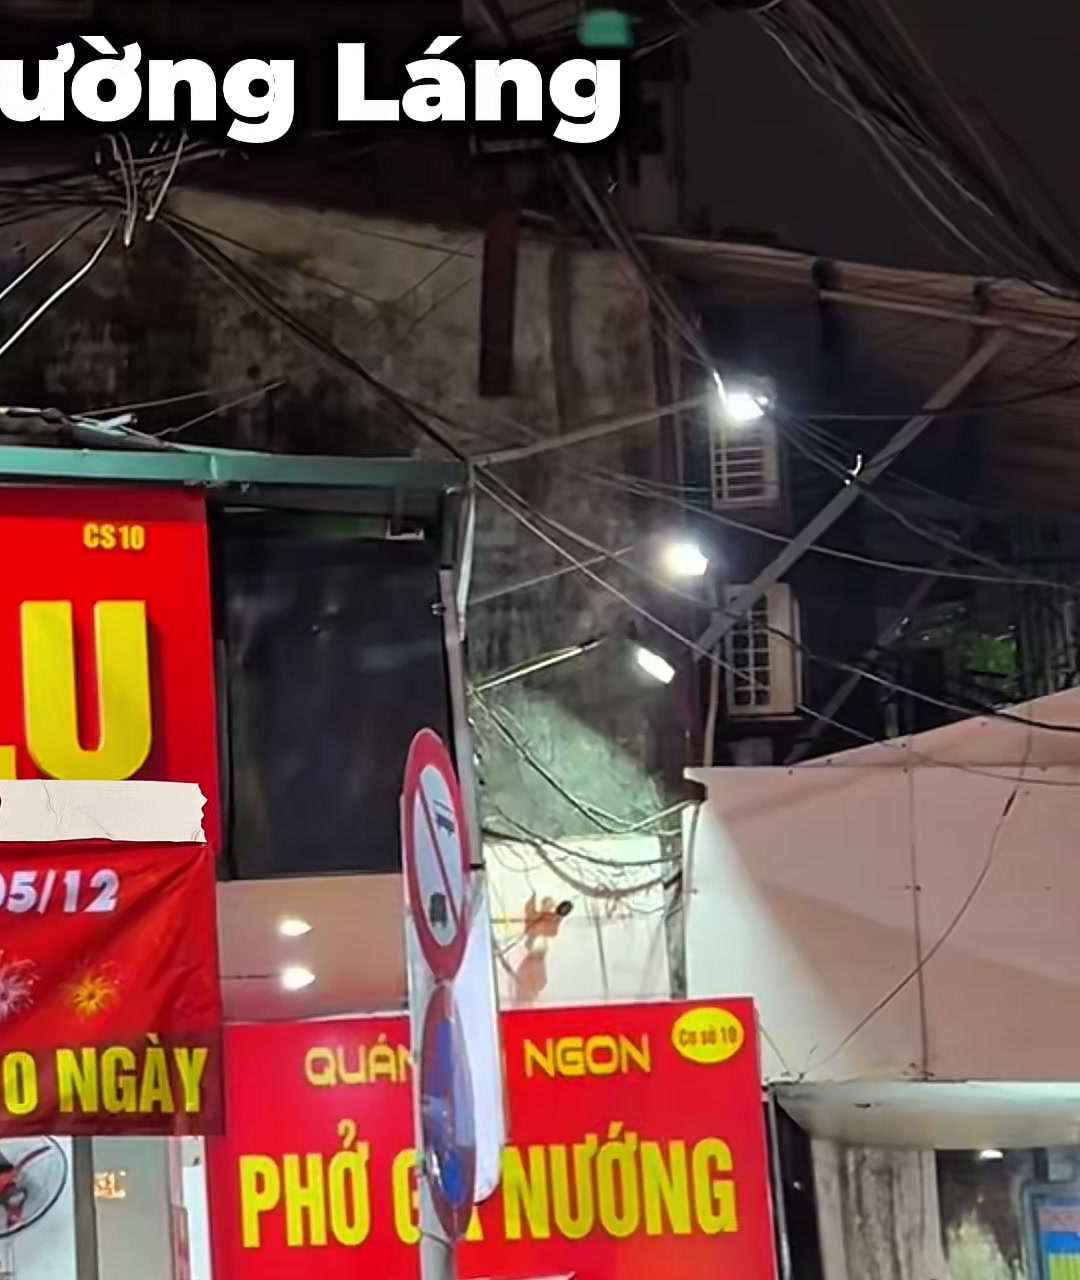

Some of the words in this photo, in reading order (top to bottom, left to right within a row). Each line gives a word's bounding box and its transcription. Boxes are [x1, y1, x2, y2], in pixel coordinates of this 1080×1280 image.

[84, 524, 115, 548] CS
[119, 526, 144, 549] 10
[720, 1026, 739, 1043] 10
[56, 1033, 208, 1112] NGÀY
[524, 1036, 650, 1077] NGON
[239, 1120, 370, 1248] PHỞ
[500, 1121, 738, 1240] NƯỚNG
